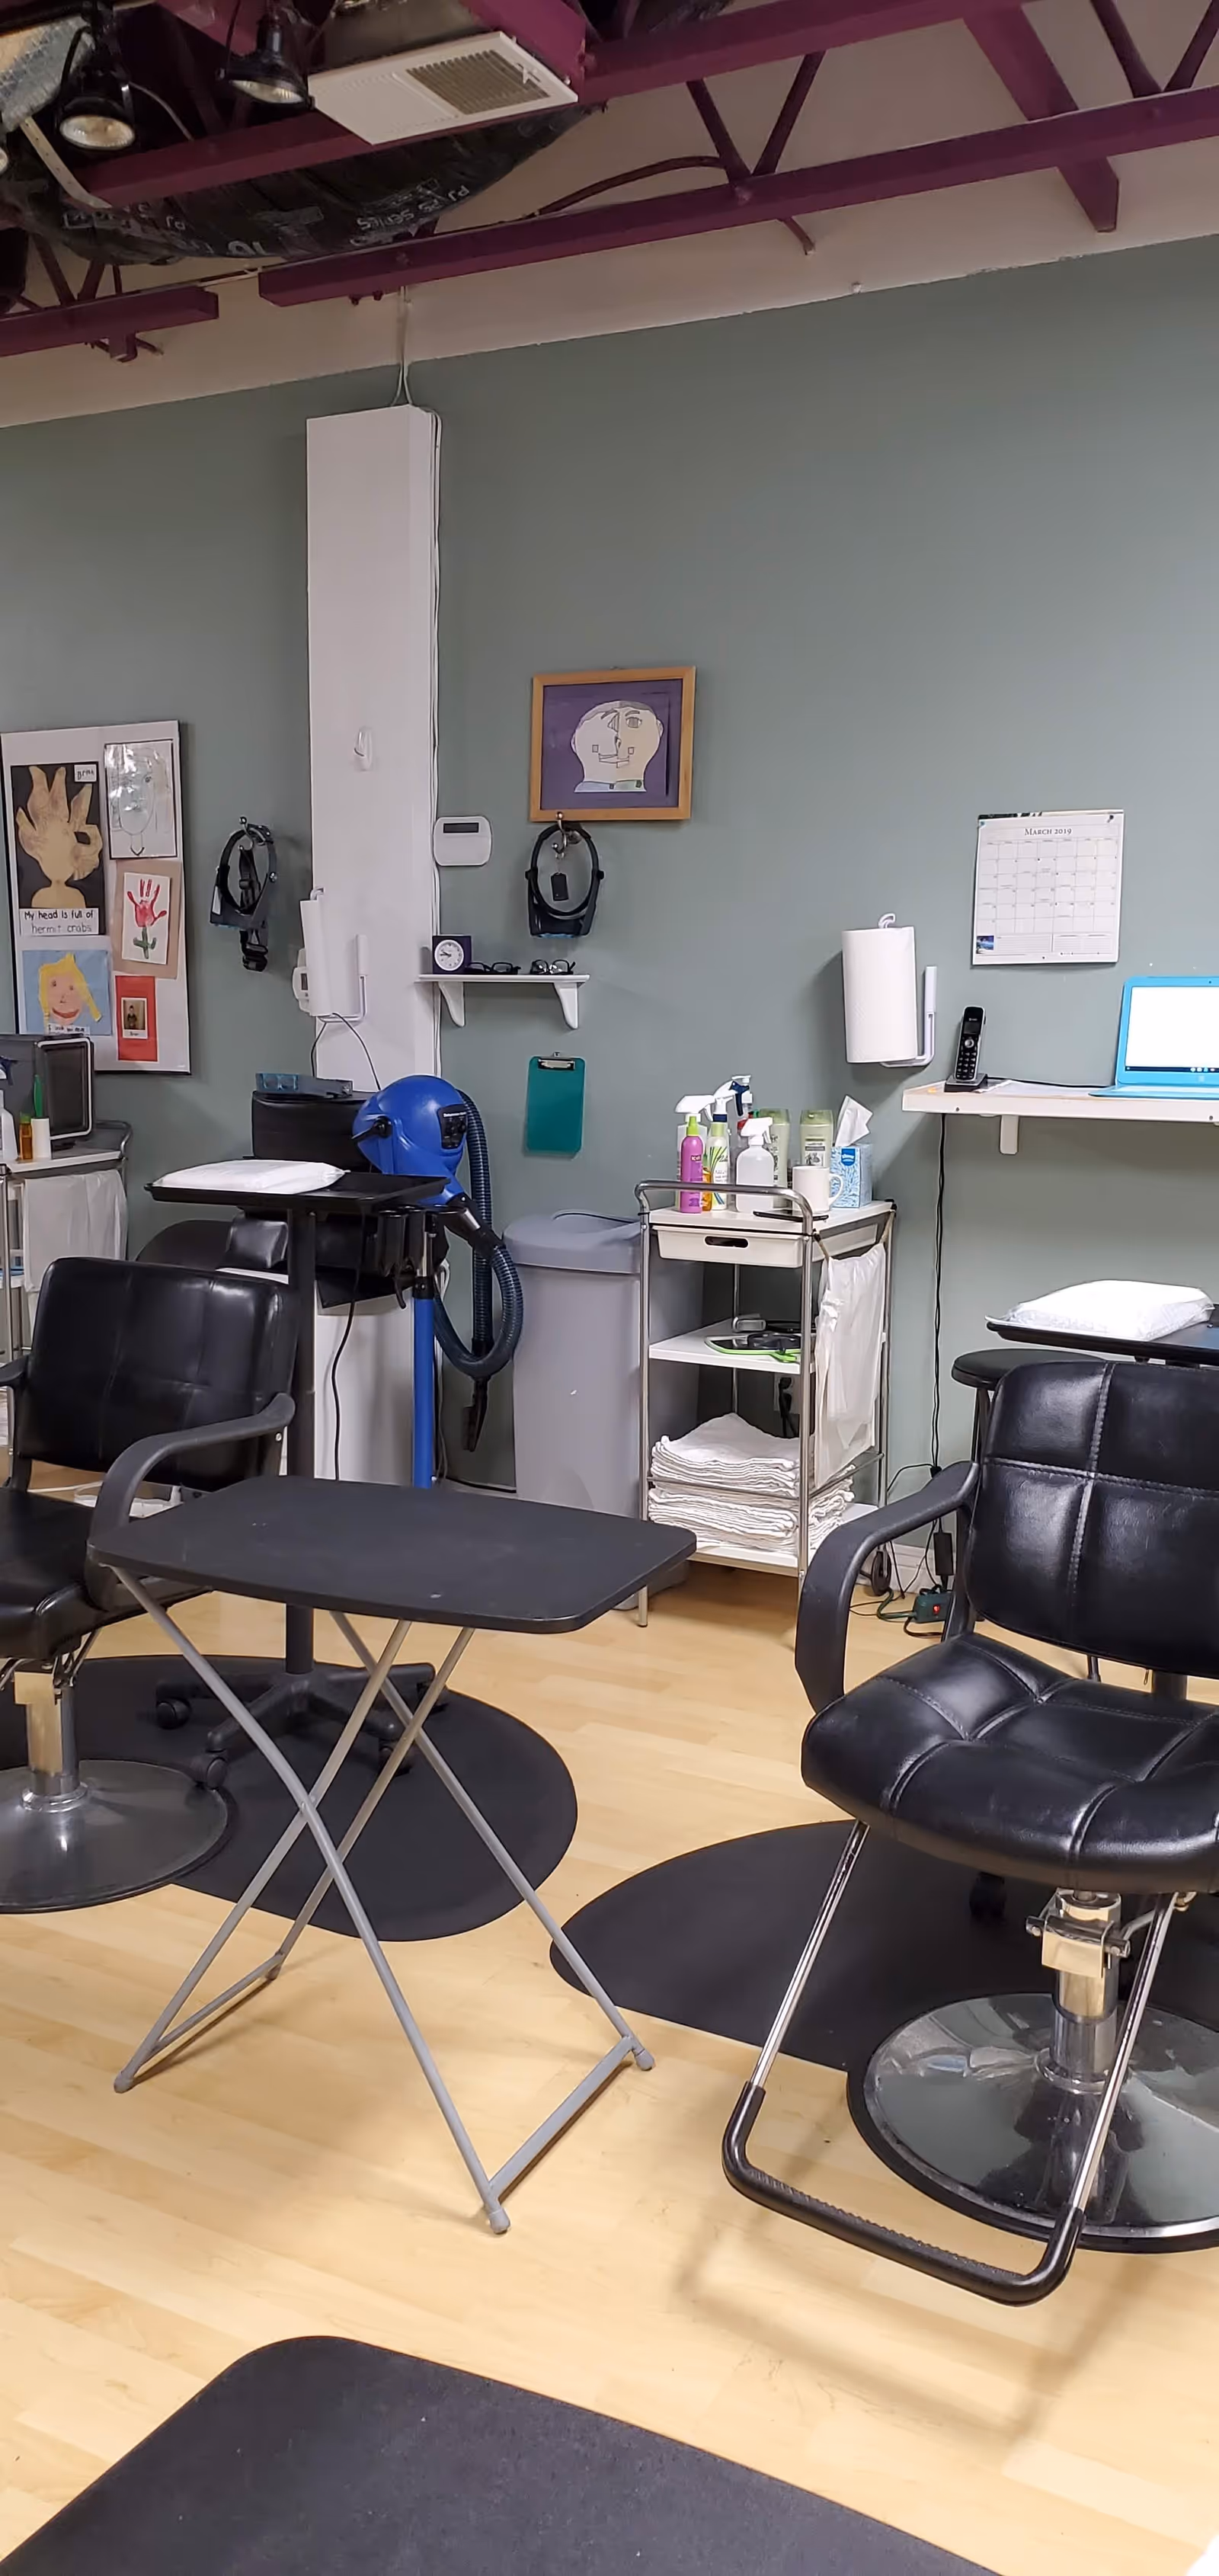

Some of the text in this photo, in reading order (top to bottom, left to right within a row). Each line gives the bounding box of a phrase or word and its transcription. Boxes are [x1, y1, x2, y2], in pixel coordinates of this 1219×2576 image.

[24, 910, 34, 921] My
[38, 909, 58, 920] head
[71, 910, 83, 919] full
[85, 909, 93, 918] of
[31, 922, 92, 934] hermit crabs
